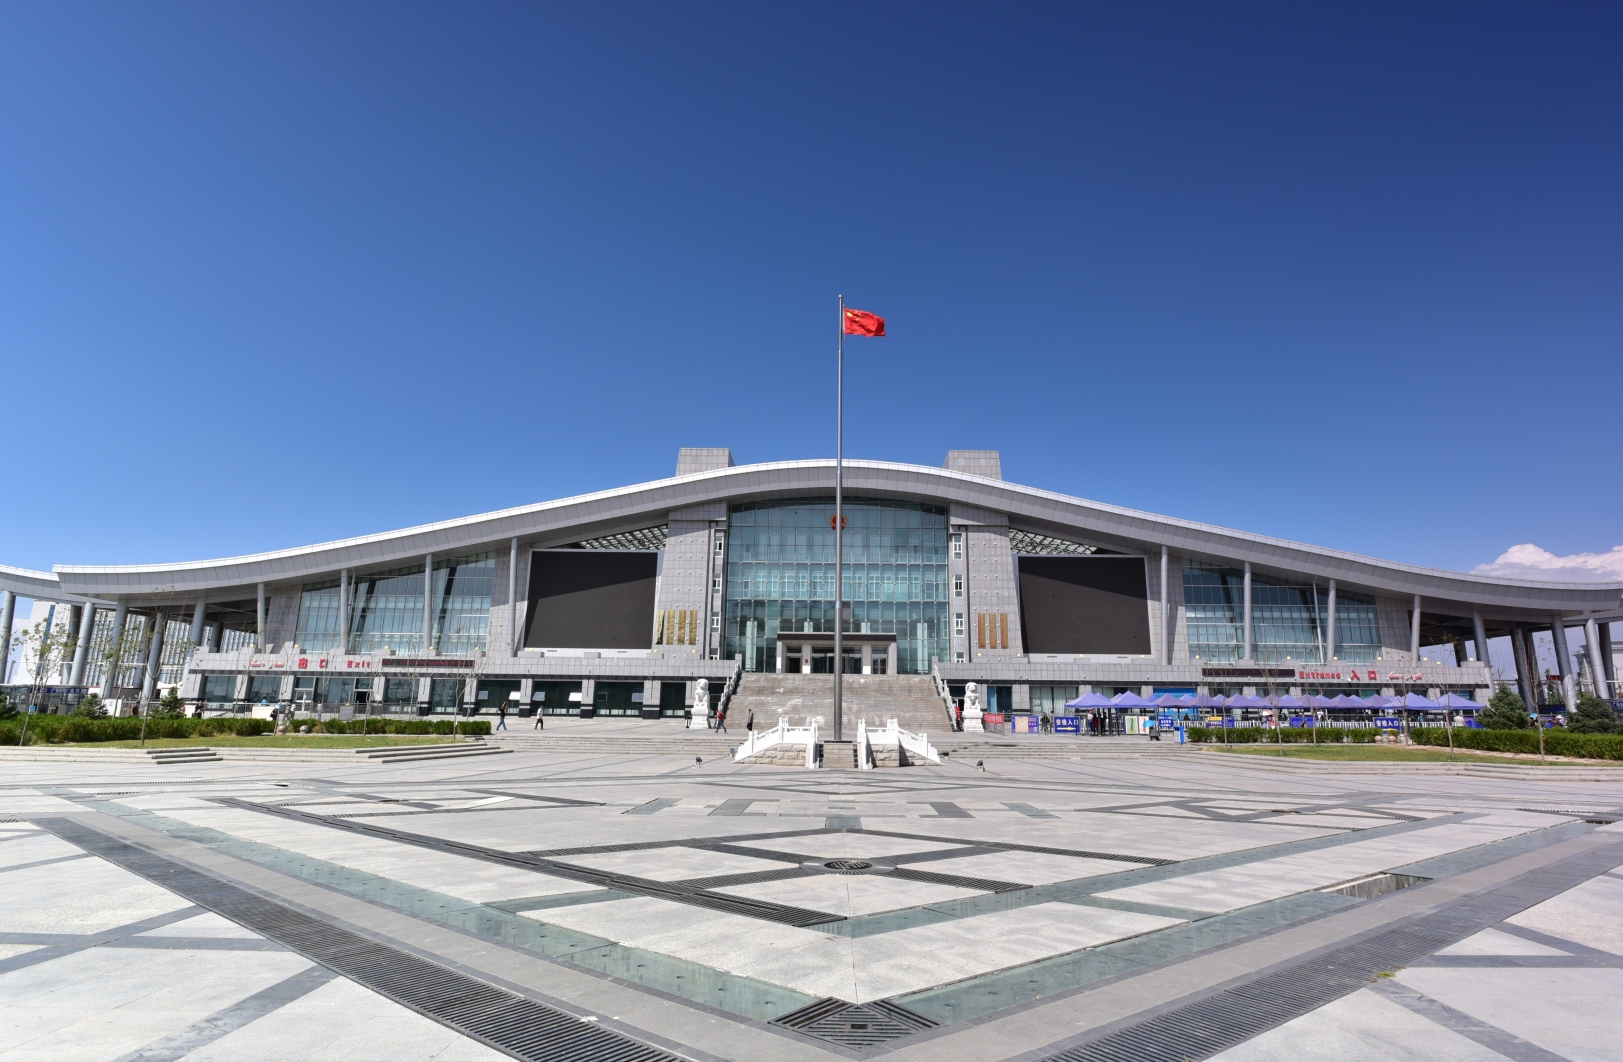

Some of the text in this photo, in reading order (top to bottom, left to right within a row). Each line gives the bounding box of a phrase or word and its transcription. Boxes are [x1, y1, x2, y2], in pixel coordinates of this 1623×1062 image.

[298, 657, 328, 669] 出口
[347, 659, 371, 668] Exit
[1299, 670, 1341, 679] Entrance
[1350, 669, 1378, 681] 入口
[1056, 718, 1079, 726] 安检入口
[1375, 719, 1399, 727] 安检入口
